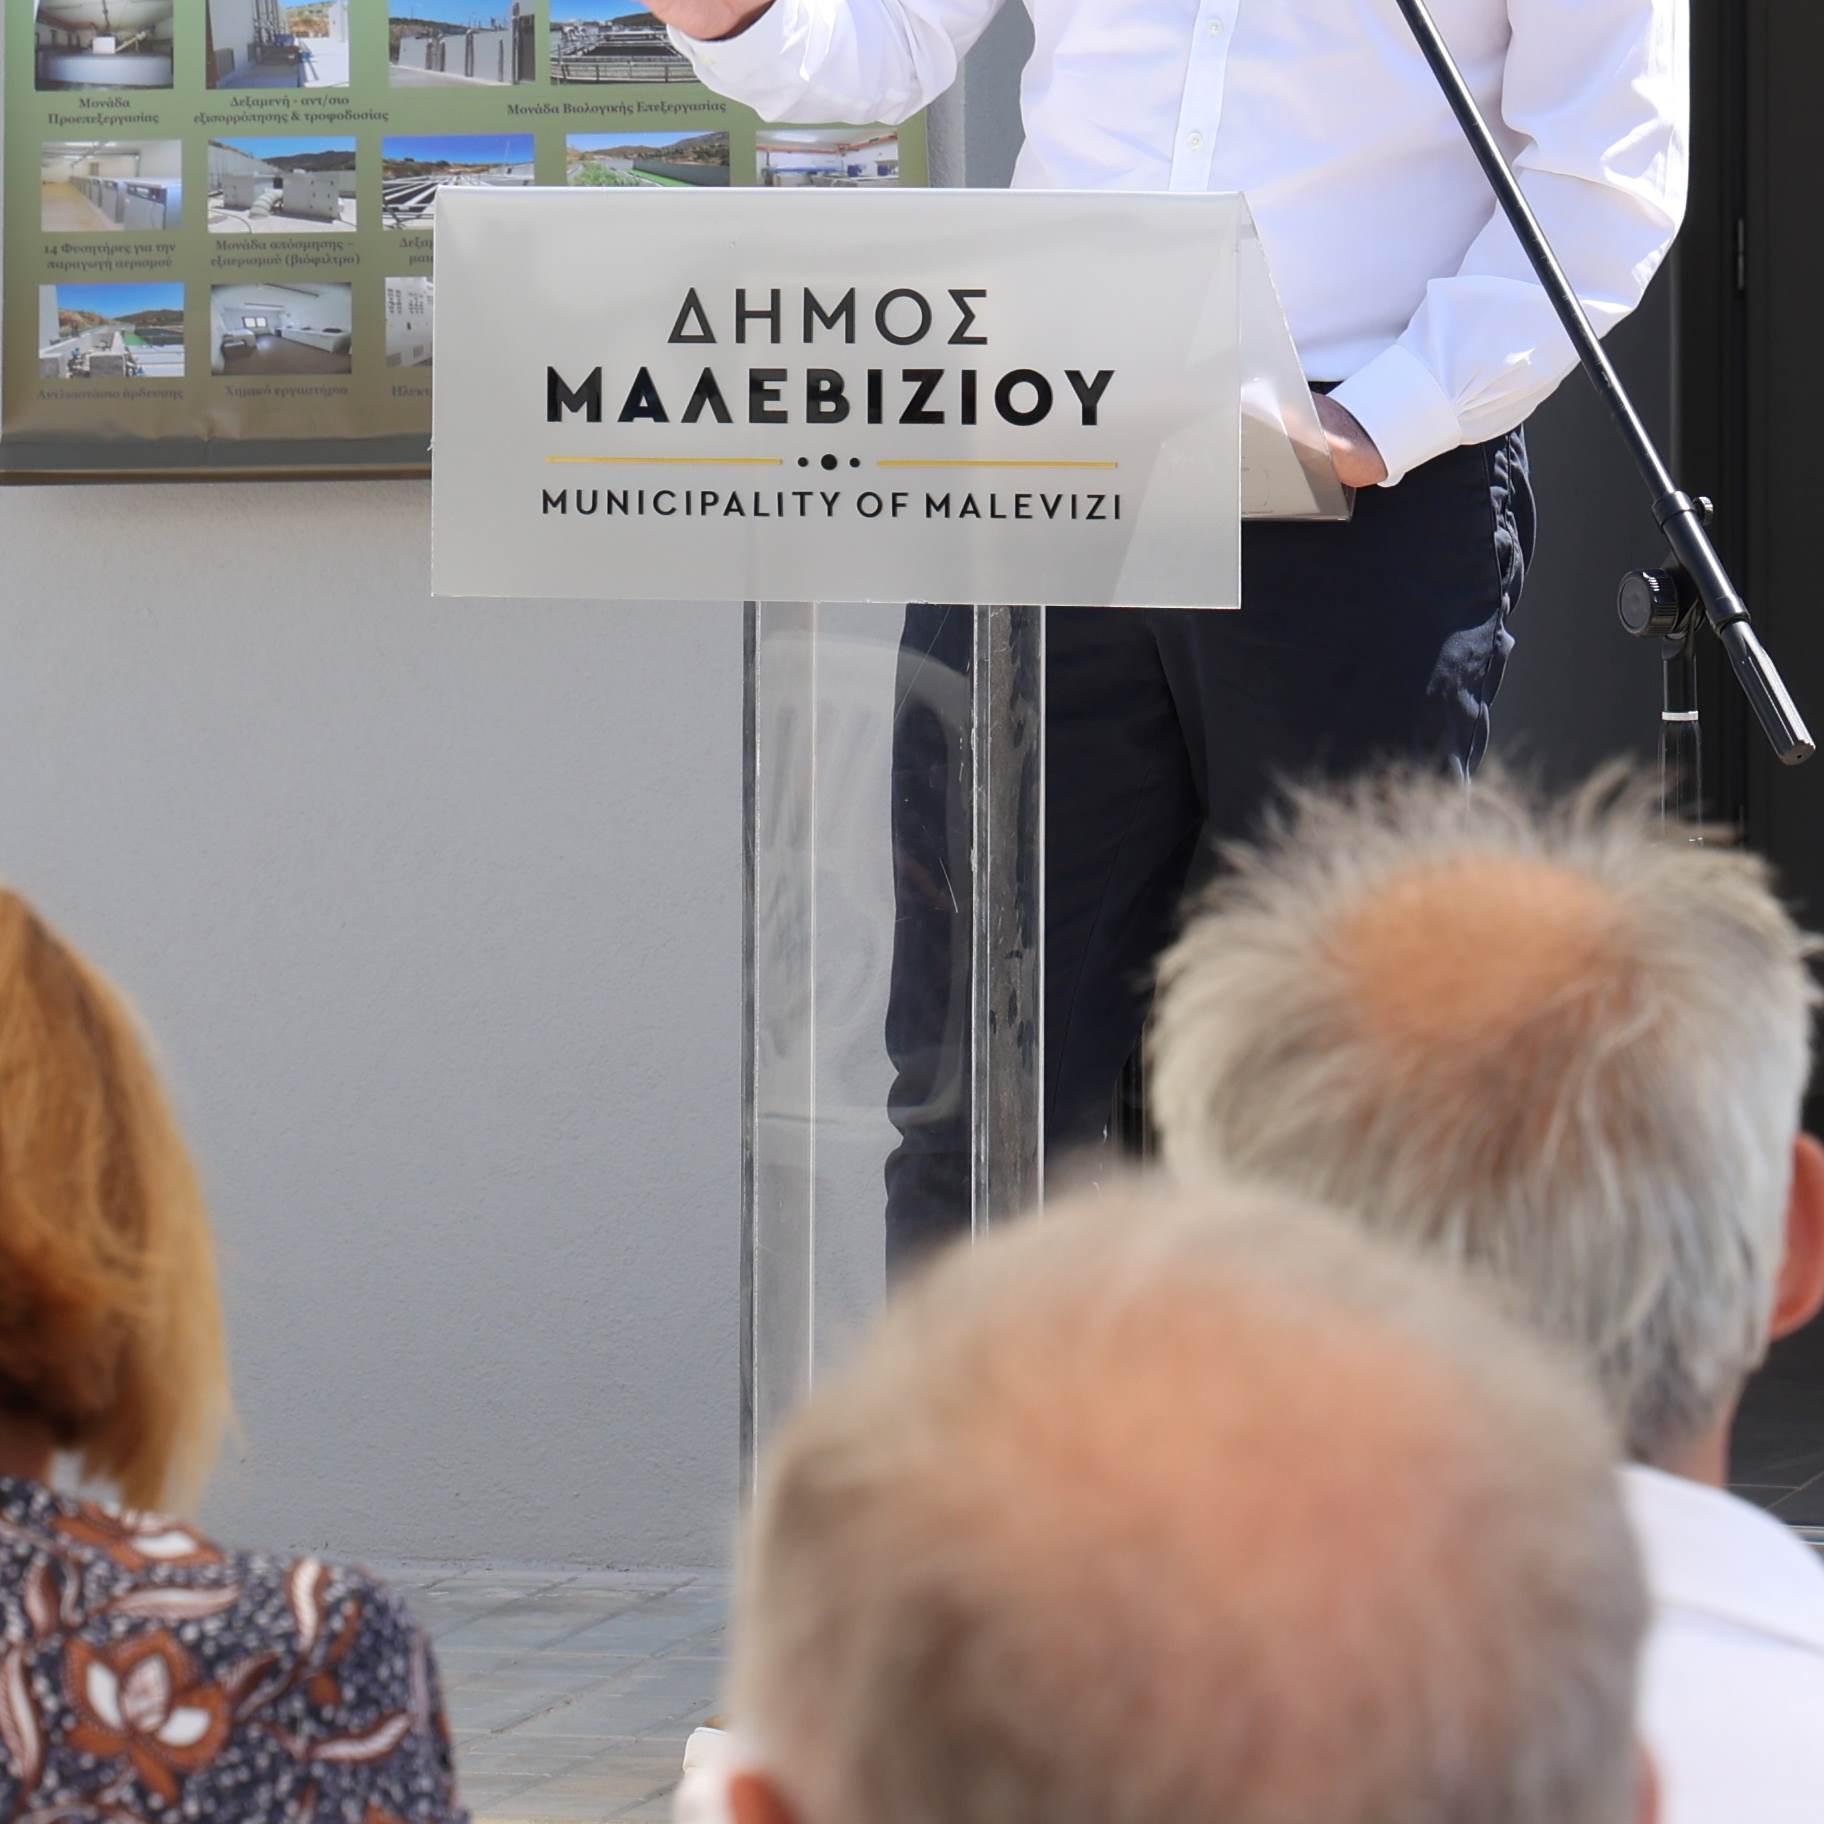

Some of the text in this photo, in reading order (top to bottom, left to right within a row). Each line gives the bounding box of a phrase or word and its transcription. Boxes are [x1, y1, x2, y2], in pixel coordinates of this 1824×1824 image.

[668, 287, 988, 346] ΔΗΜΟΣ
[547, 366, 1115, 426] ΜΑΛΕΒΙΖΙΟΥ
[543, 489, 1120, 520] MUNICIPALITY OF MALEVIZI
